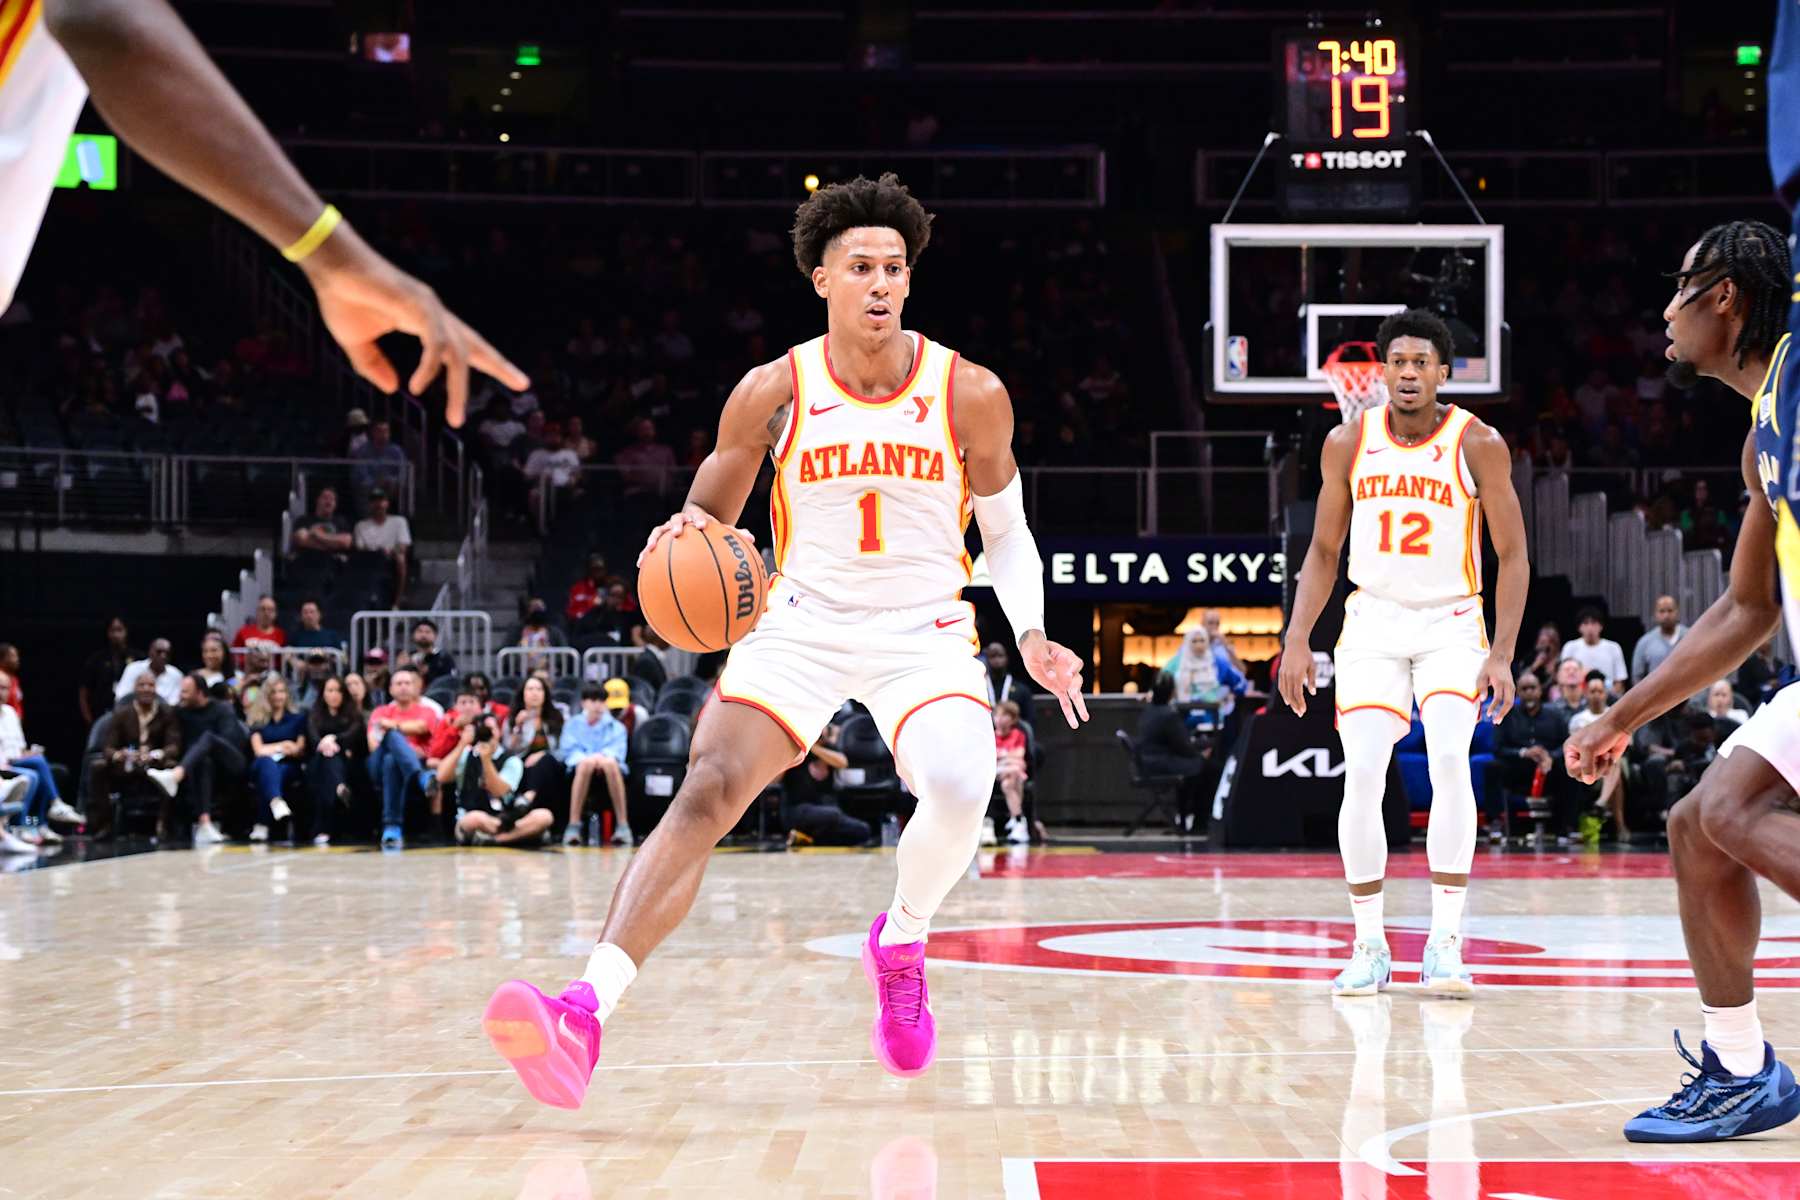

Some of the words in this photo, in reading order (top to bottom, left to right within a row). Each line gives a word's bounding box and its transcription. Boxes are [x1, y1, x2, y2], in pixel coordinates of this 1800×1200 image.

[1318, 40, 1396, 76] 7:40
[1331, 77, 1390, 139] 19
[1322, 151, 1407, 169] TISSOT
[799, 442, 944, 482] ATLANTA
[1356, 474, 1454, 508] ATLANTA
[858, 490, 884, 554] 1
[1379, 511, 1432, 556] 12
[723, 534, 755, 620] Wilson
[1050, 553, 1169, 583] ELTA
